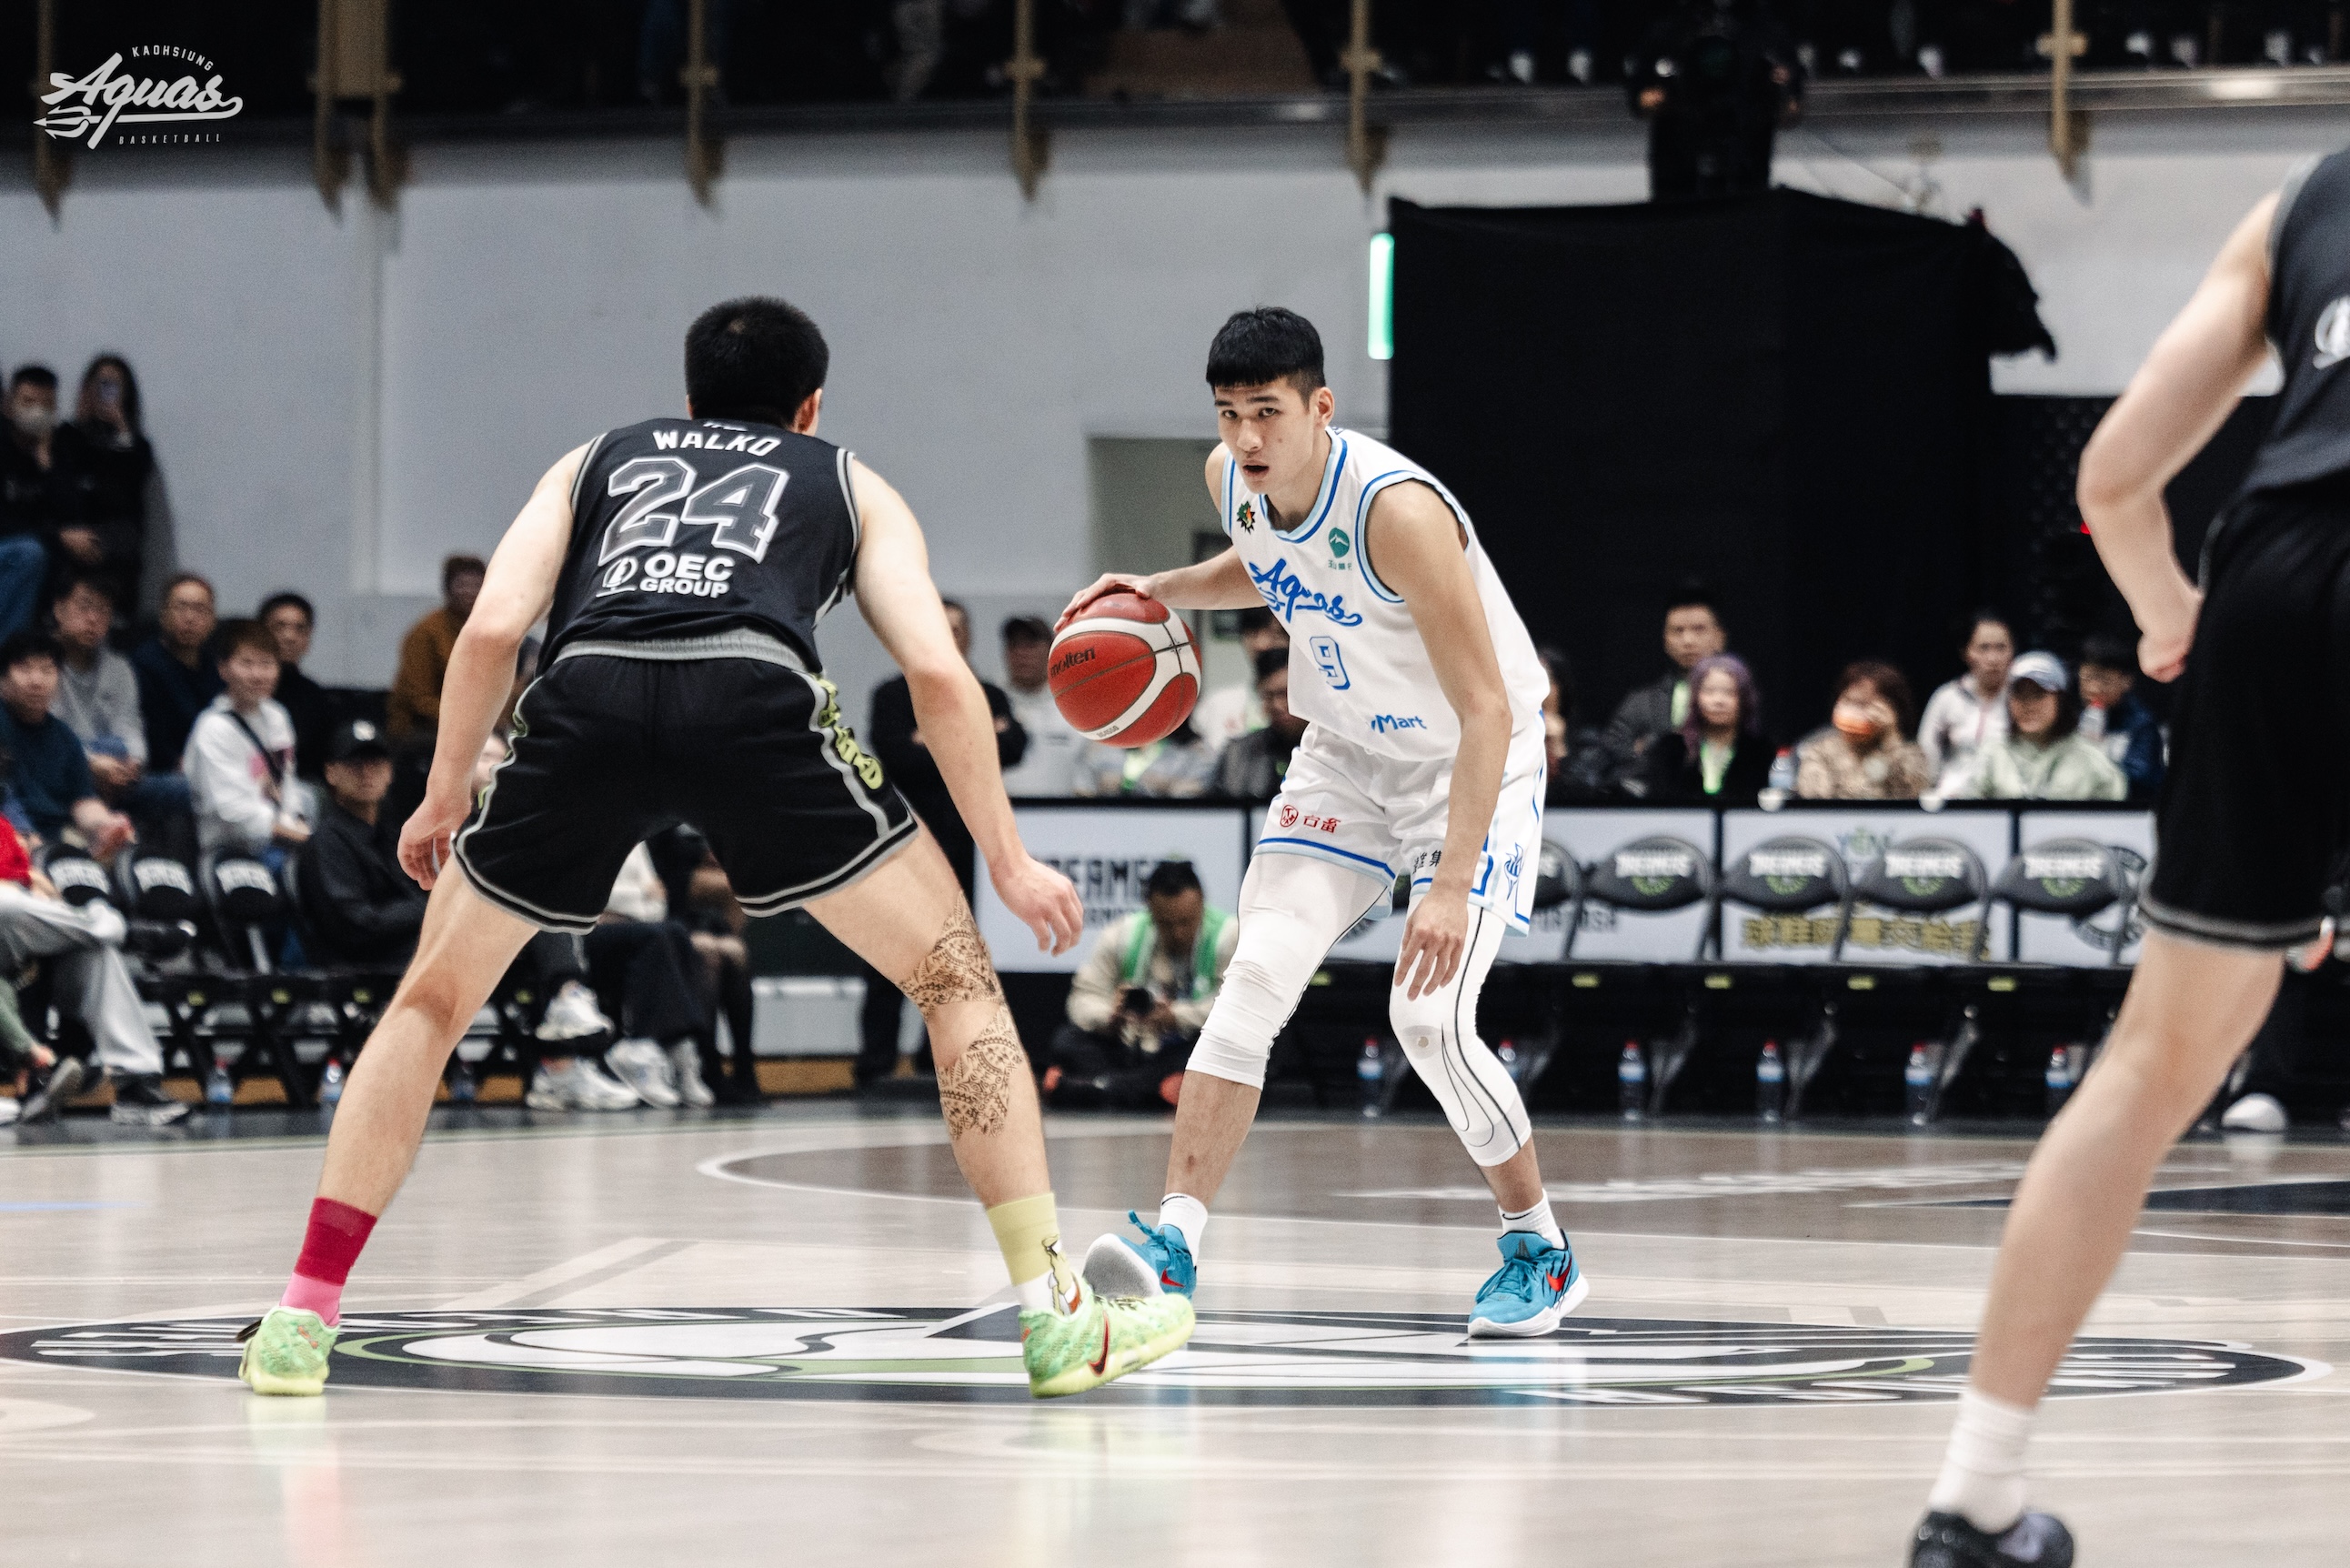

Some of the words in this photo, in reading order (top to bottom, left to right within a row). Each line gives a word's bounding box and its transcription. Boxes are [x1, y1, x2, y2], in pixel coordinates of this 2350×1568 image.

[652, 430, 781, 457] WALKO
[598, 456, 790, 564] 24
[644, 551, 736, 581] OEC
[639, 577, 729, 598] GROUP
[1249, 558, 1362, 627] Aquas
[1051, 647, 1095, 678] molten
[1310, 636, 1351, 690] 9
[1371, 713, 1427, 734] Mart
